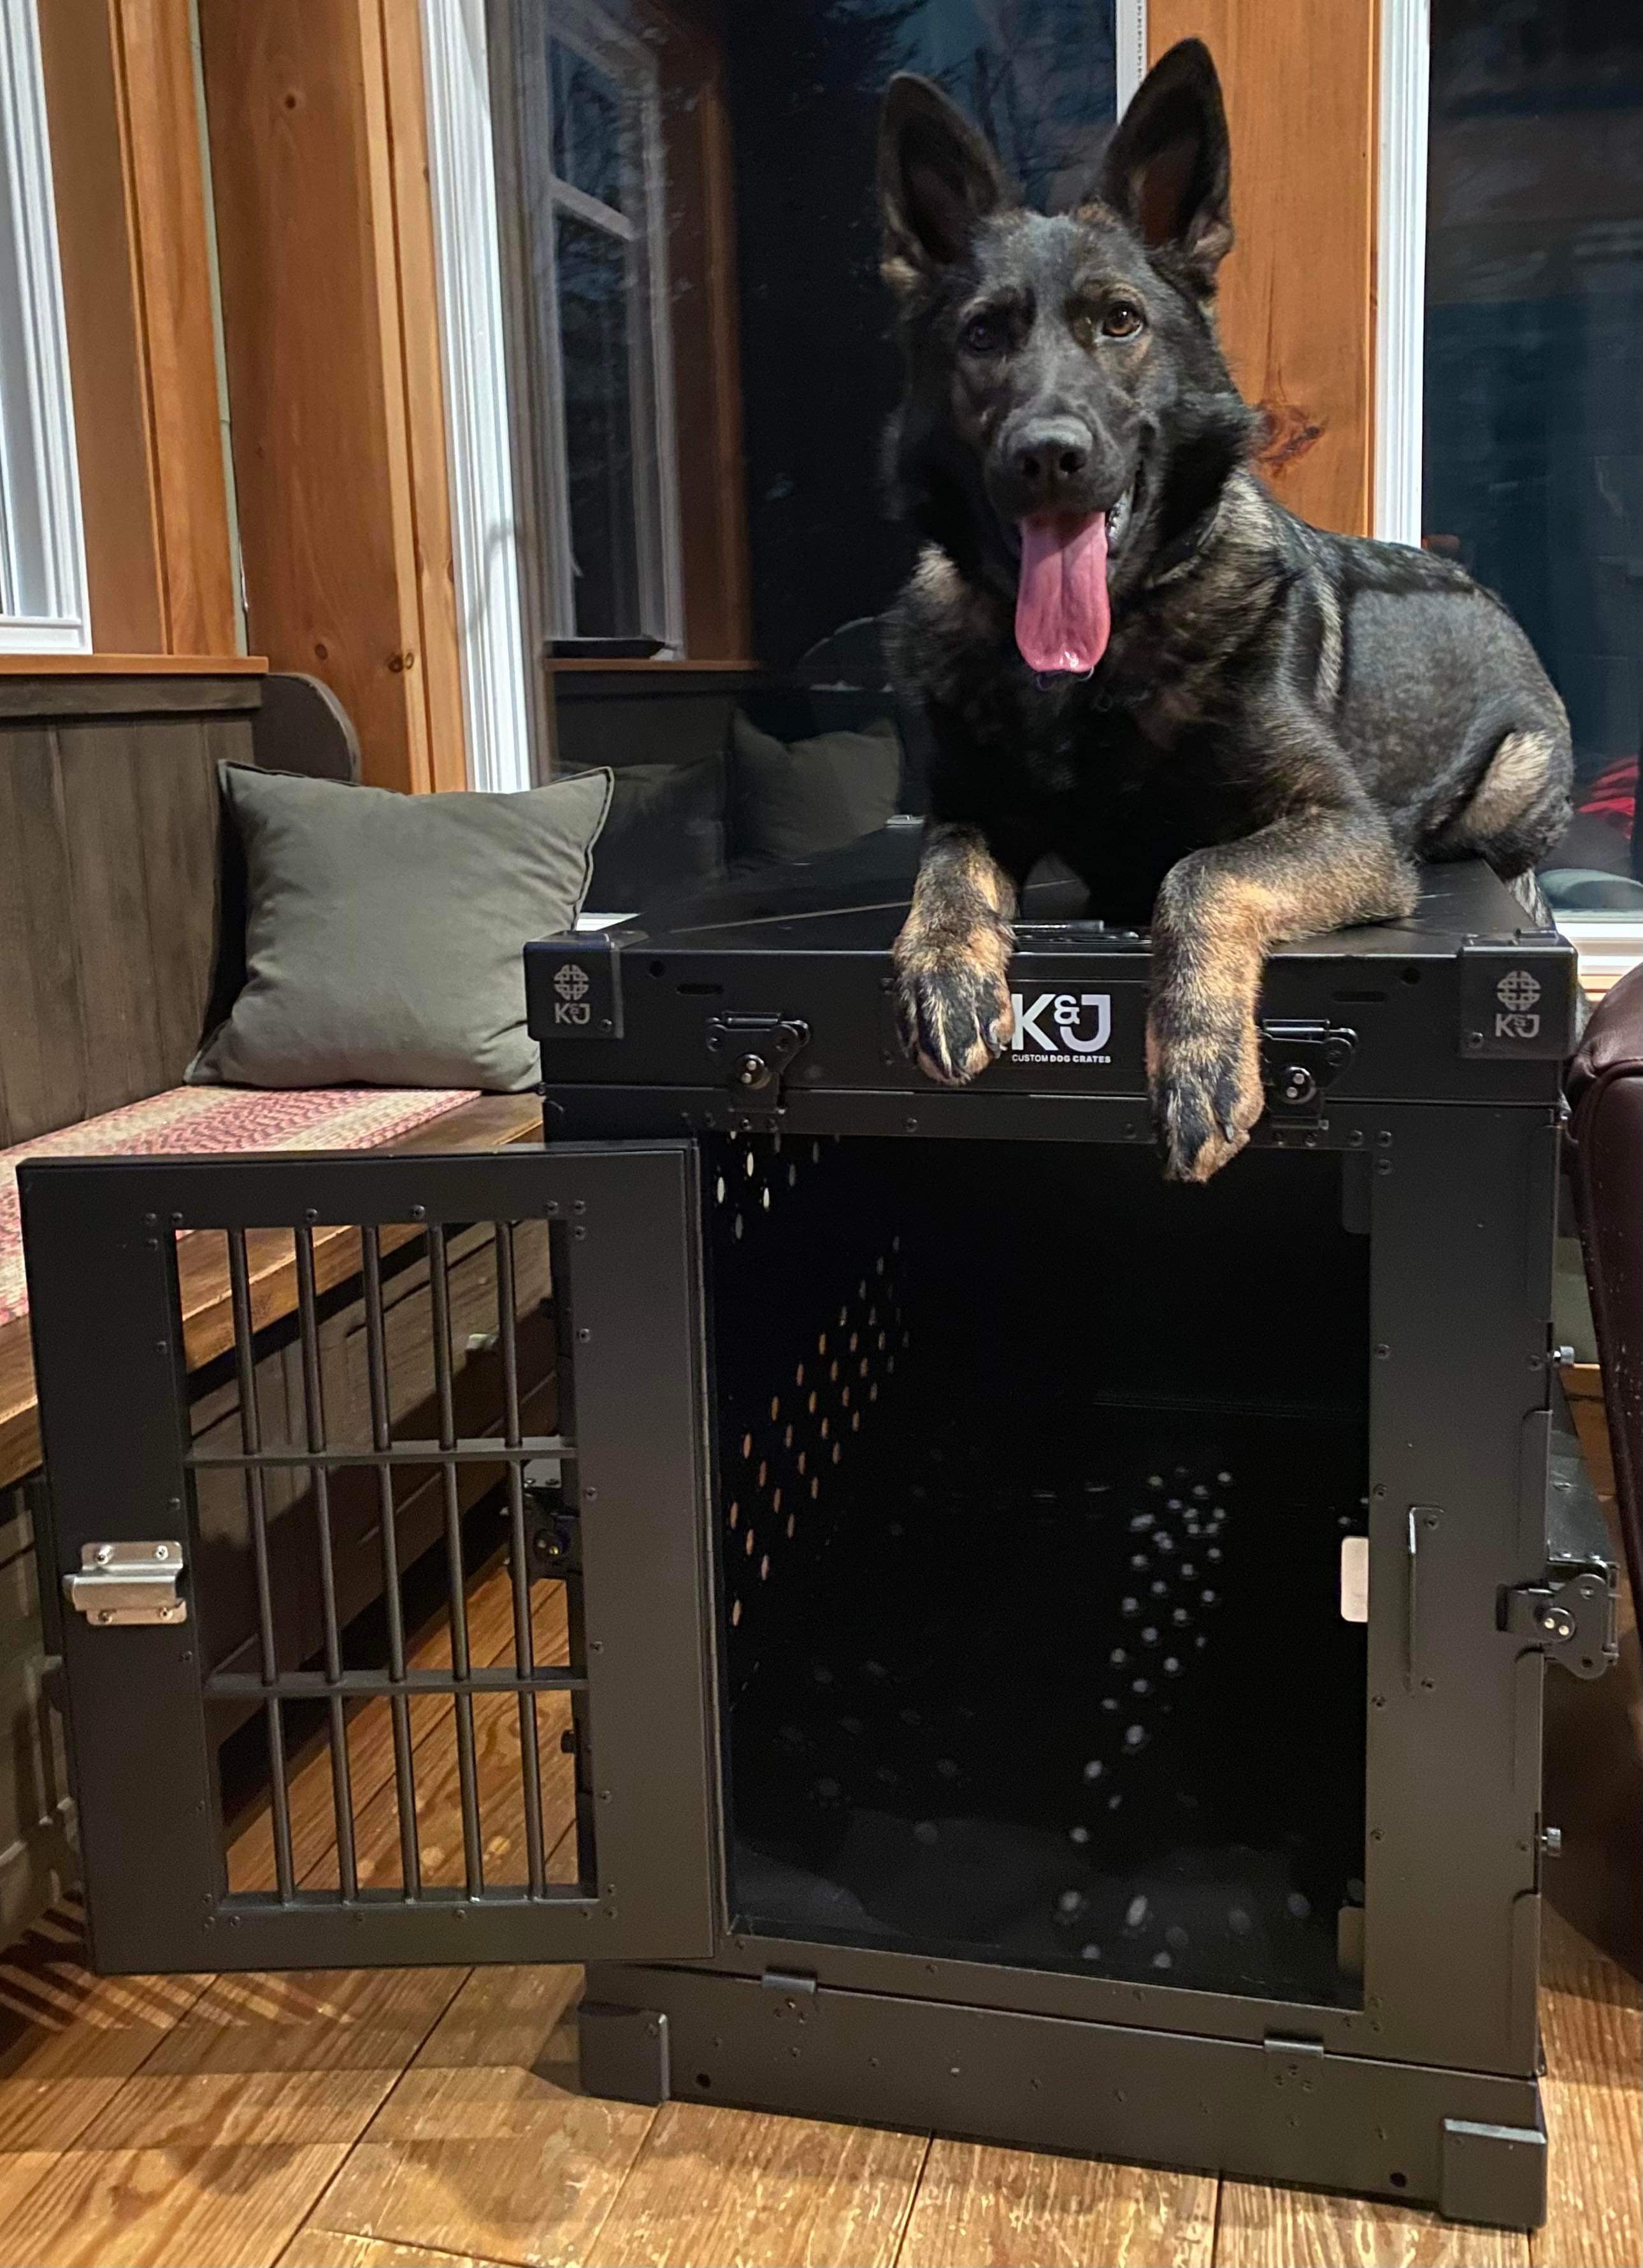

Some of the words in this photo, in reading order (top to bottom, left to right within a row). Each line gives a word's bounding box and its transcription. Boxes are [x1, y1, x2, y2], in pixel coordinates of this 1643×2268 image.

[1011, 994, 1111, 1053] K&J
[1012, 1054, 1049, 1062] CUSTOM
[1049, 1055, 1071, 1063] DOG
[1072, 1055, 1111, 1064] CRATES
